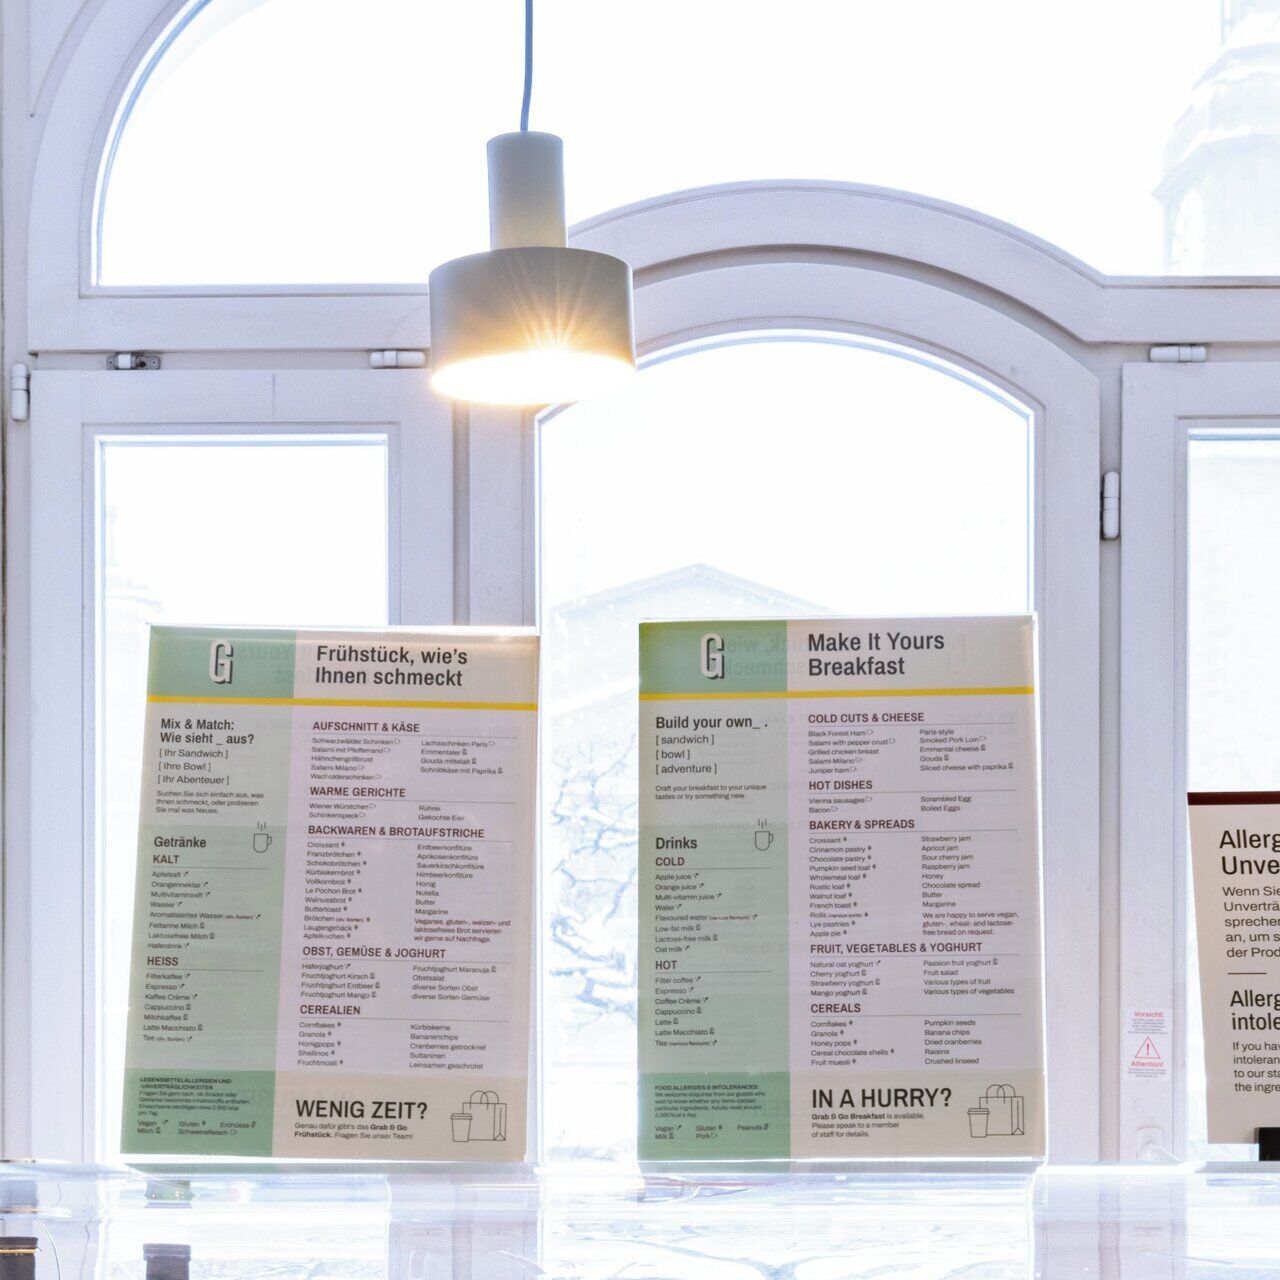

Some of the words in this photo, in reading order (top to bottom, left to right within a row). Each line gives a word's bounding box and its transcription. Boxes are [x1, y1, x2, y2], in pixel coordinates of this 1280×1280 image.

[808, 632, 861, 652] Make
[868, 632, 881, 651] It
[886, 632, 945, 650] Yours
[317, 645, 414, 666] Frühstück,
[421, 647, 468, 665] wie's
[809, 656, 905, 676] Breakfast
[316, 666, 366, 684] Ihnen
[373, 668, 463, 686] schmeckt
[161, 718, 181, 729] Mix
[184, 718, 193, 730] &
[196, 719, 234, 730] Match:
[808, 714, 838, 724] COLD
[840, 713, 869, 723] CUTS
[871, 713, 879, 723] &
[881, 712, 924, 722] CHEESE
[312, 721, 379, 732] AUFSCHNITT
[381, 722, 389, 732] &
[392, 721, 420, 733] KÄSE
[809, 780, 831, 790] HOT
[834, 780, 873, 790] DISHES
[310, 786, 349, 796] WARME
[352, 787, 406, 798] GERICHTE
[920, 795, 957, 803] Scrambled
[958, 795, 972, 803] Egg
[809, 820, 852, 830] BAKERY
[854, 820, 861, 830] &
[864, 819, 915, 830] SPREADS
[308, 825, 376, 836] BACKWAREN
[378, 826, 386, 836] &
[389, 826, 484, 838] BROTAUFSTRICHE
[154, 836, 206, 848] Getränke
[656, 836, 698, 850] Drinks
[153, 854, 180, 864] KALT
[306, 850, 356, 858] Franzbrötchen
[655, 856, 685, 867] COLD
[1222, 886, 1260, 897] Wenn
[415, 908, 449, 916] Margarine
[302, 946, 333, 957] OBST,
[336, 945, 382, 957] GEMÜSE
[384, 948, 392, 958] &
[394, 948, 446, 958] JOGHURT
[810, 944, 843, 955] FRUIT,
[846, 943, 917, 954] VEGETABLES
[919, 943, 927, 952] &
[929, 942, 982, 952] YOGHURT
[147, 956, 179, 966] HEISS
[655, 960, 678, 970] HOT
[412, 974, 445, 982] Obstsalat
[300, 1004, 361, 1015] CEREALIEN
[654, 1008, 696, 1016] Cappuccino
[810, 1003, 861, 1014] CEREALS
[812, 1089, 833, 1108] IN
[839, 1089, 855, 1108] A
[862, 1087, 952, 1108] HURRY?
[296, 1099, 364, 1118] WENIG
[371, 1101, 428, 1120] ZEIT?
